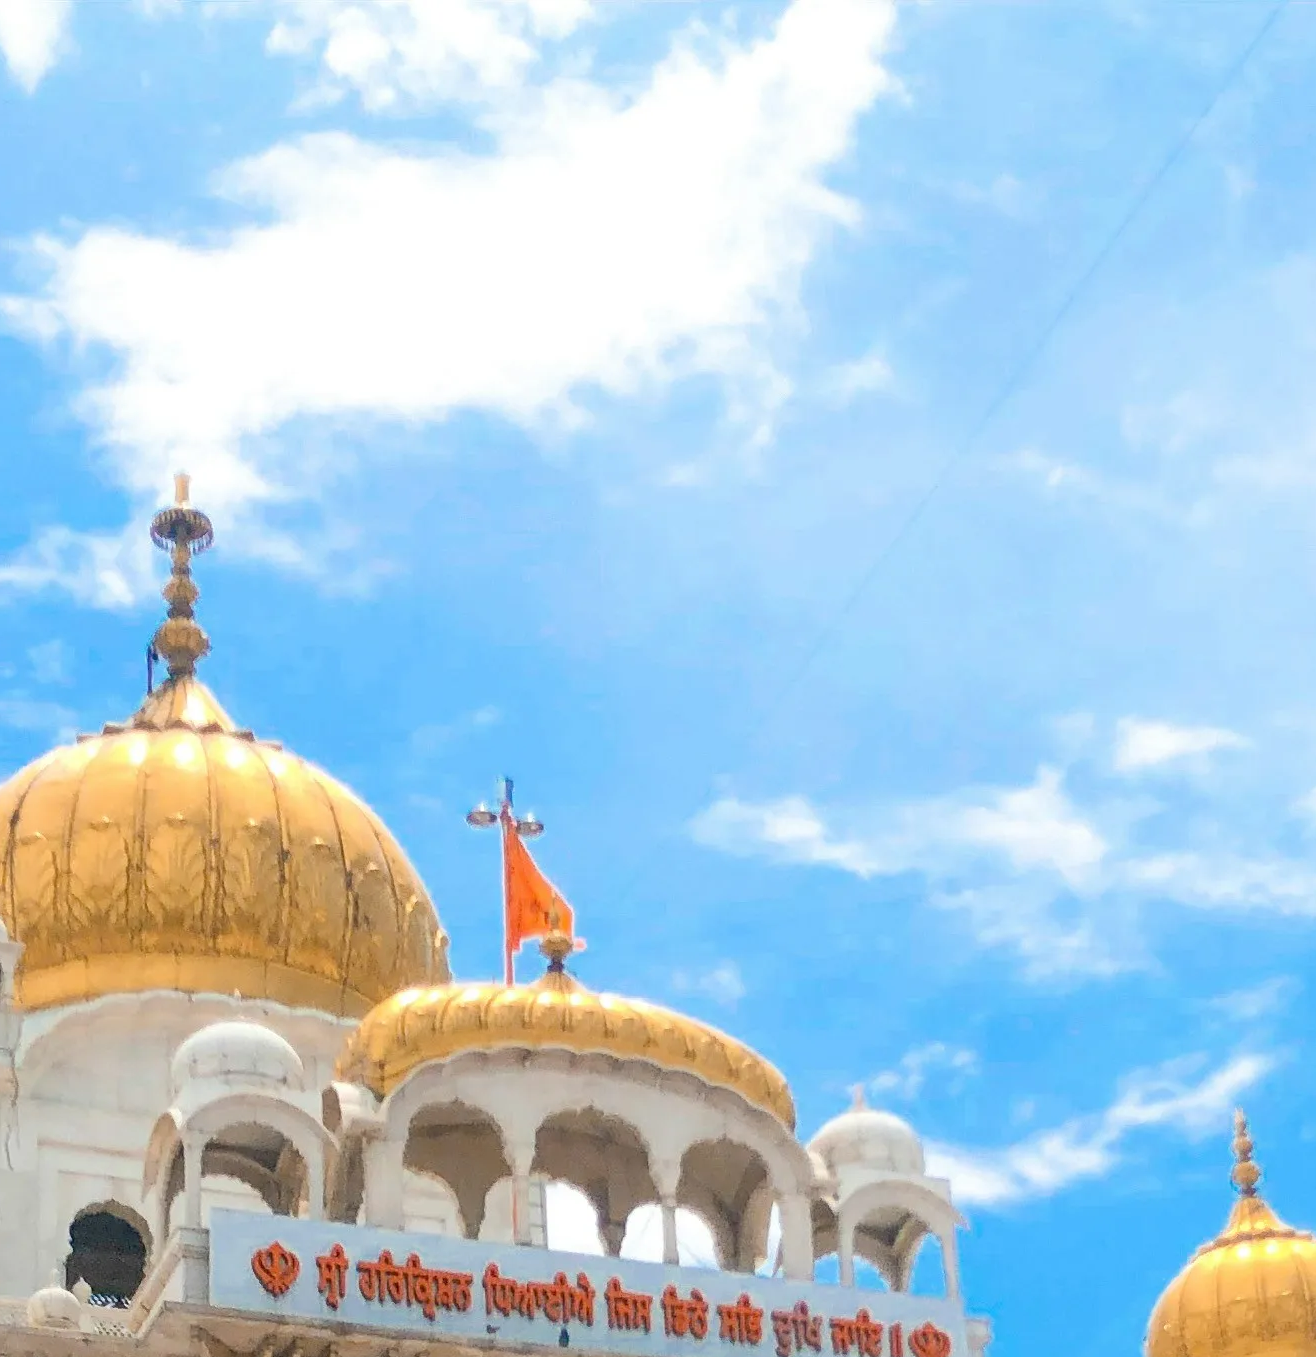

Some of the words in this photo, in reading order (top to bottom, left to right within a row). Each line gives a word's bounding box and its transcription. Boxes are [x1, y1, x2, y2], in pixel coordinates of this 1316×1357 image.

[315, 1242, 349, 1311] ਸ੍ਰੀ
[604, 1276, 653, 1334] ਜਿਸ
[717, 1292, 764, 1344] ਸਭਿ
